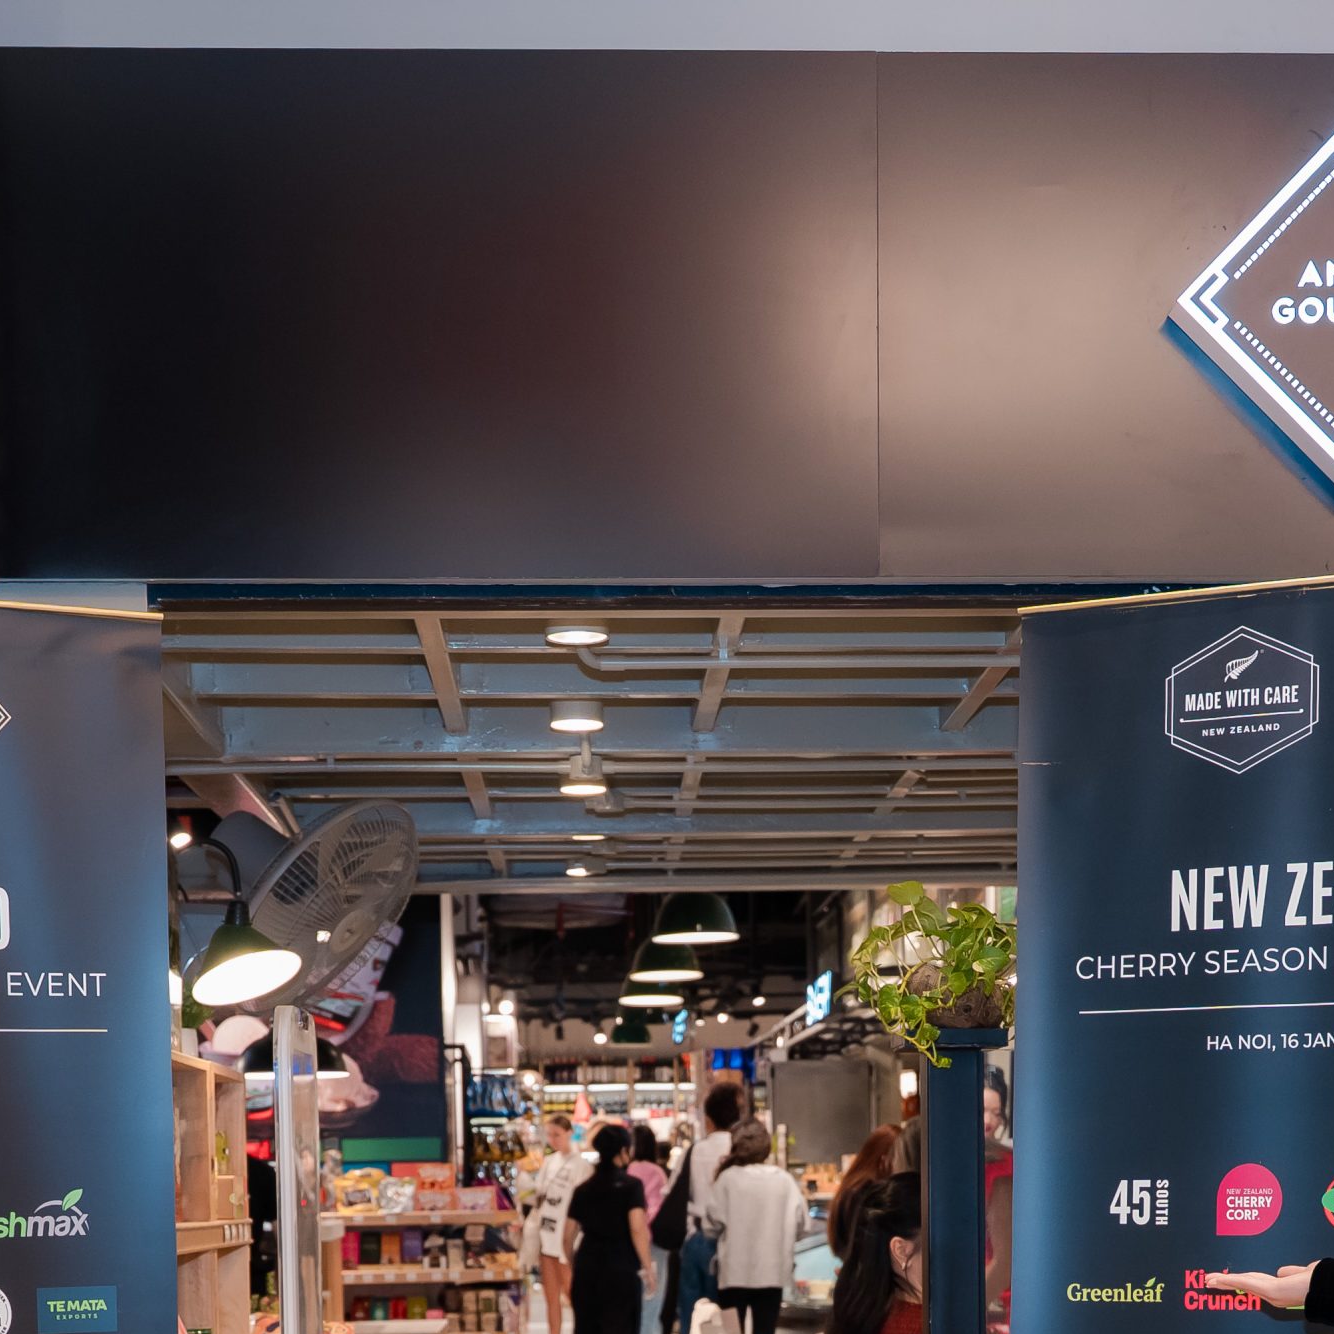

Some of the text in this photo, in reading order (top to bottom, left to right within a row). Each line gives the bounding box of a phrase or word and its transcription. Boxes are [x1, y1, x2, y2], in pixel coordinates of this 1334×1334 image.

[1185, 685, 1298, 711] MADE WITH CARE
[1202, 723, 1279, 736] NEW ZEALAND
[1171, 865, 1269, 931] NEW
[1076, 952, 1195, 979] CHERRY
[1205, 946, 1327, 974] SEASON
[7, 972, 106, 996] EVENT
[1208, 1036, 1233, 1050] HA
[1239, 1034, 1275, 1051] NOI,
[1281, 1034, 1298, 1048] 16
[1110, 1180, 1150, 1225] 45
[1156, 1180, 1169, 1225] SOUTH
[1227, 1196, 1272, 1207] CHERRY
[1227, 1209, 1258, 1220] CORP.
[1067, 1283, 1164, 1302] Greenleaf
[1184, 1290, 1261, 1311] Crunch
[47, 1300, 107, 1312] TE MATA
